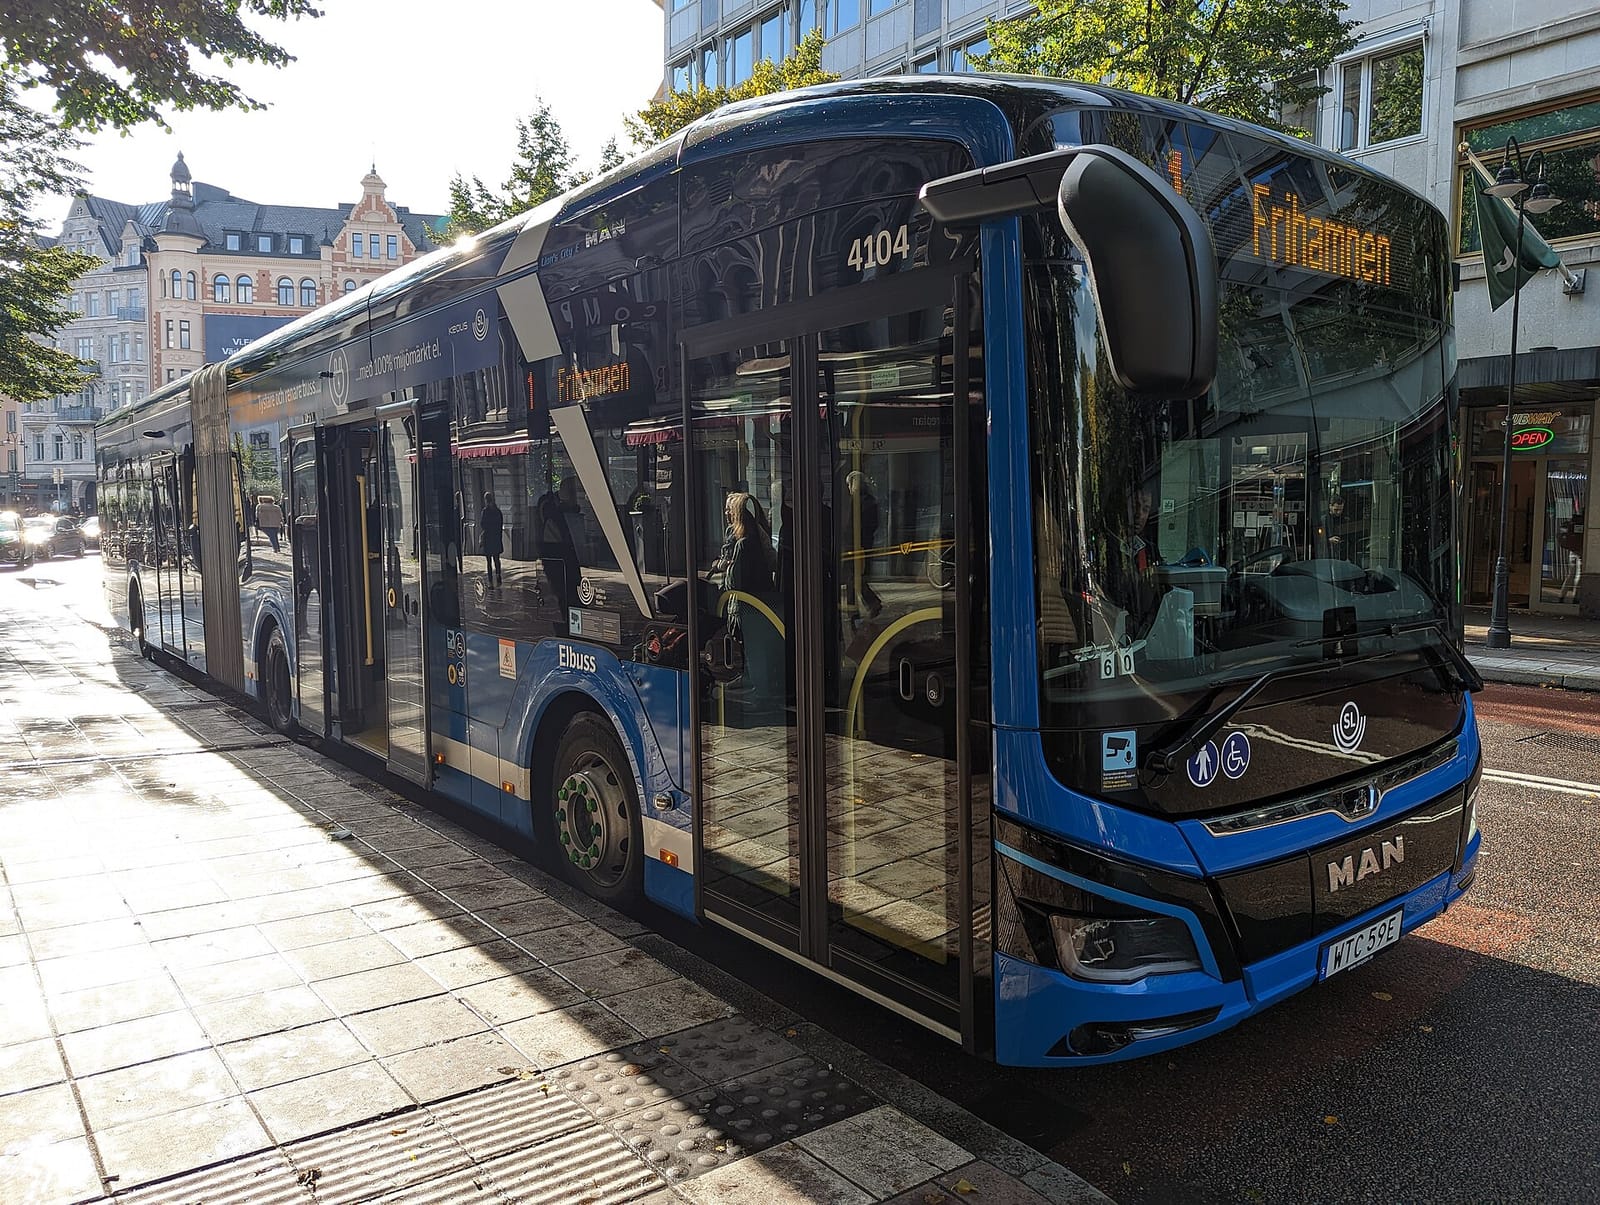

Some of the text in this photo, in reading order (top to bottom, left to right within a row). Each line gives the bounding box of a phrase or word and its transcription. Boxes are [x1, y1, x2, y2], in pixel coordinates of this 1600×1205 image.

[1168, 151, 1182, 195] 1
[585, 218, 626, 248] MAN
[847, 224, 910, 272] 4104
[1253, 183, 1390, 286] Frihamnen
[374, 353, 393, 376] 100%
[393, 343, 431, 372] miljömärkt
[527, 362, 630, 410] 1 Frihamnen
[1512, 432, 1547, 445] OPEN
[559, 644, 596, 673] Elbuss
[1328, 835, 1404, 893] MAN
[1333, 938, 1364, 970] WTC
[1367, 917, 1396, 951] 59E
